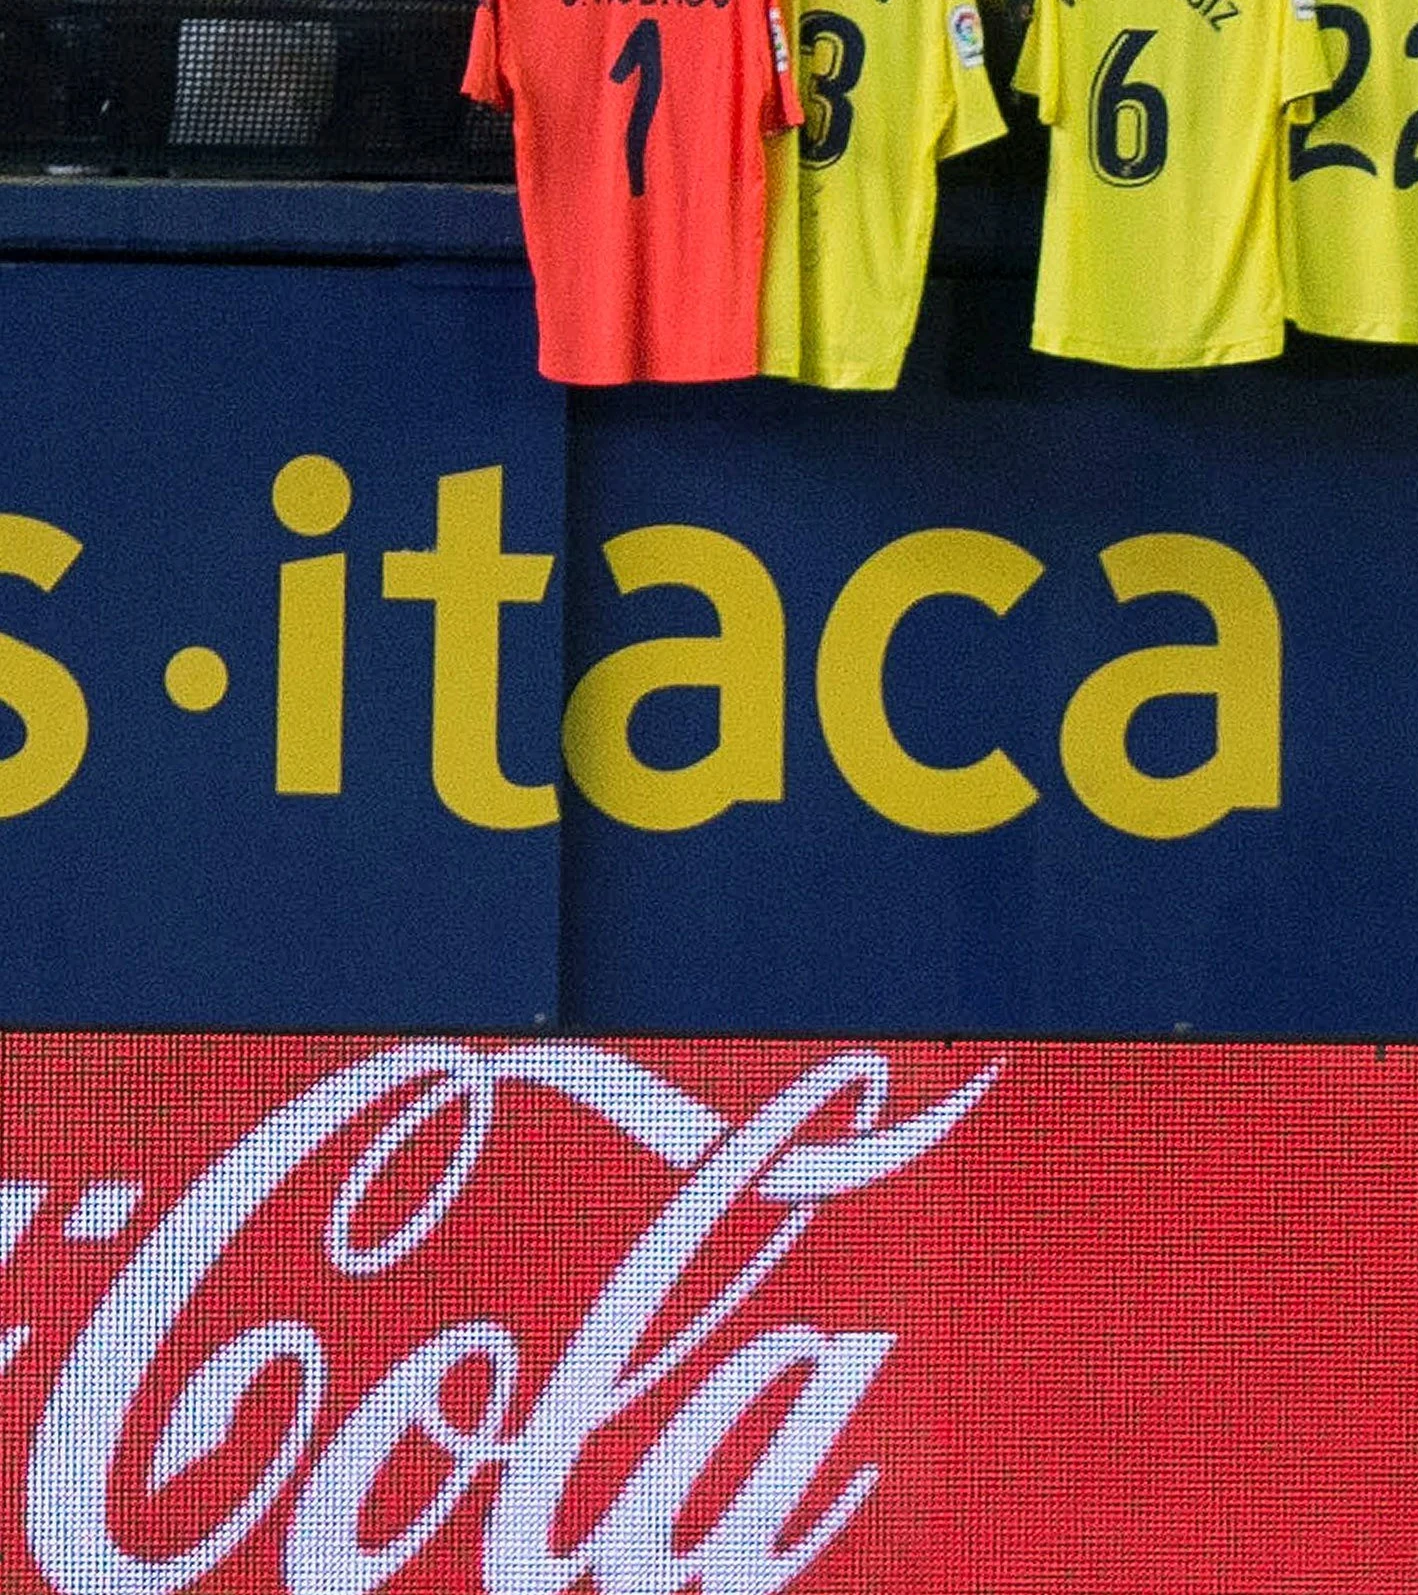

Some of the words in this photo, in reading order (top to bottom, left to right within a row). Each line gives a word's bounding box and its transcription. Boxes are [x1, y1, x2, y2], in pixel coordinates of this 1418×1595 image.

[608, 17, 662, 197] 1
[799, 8, 866, 171] 3
[1088, 28, 1169, 188] 6
